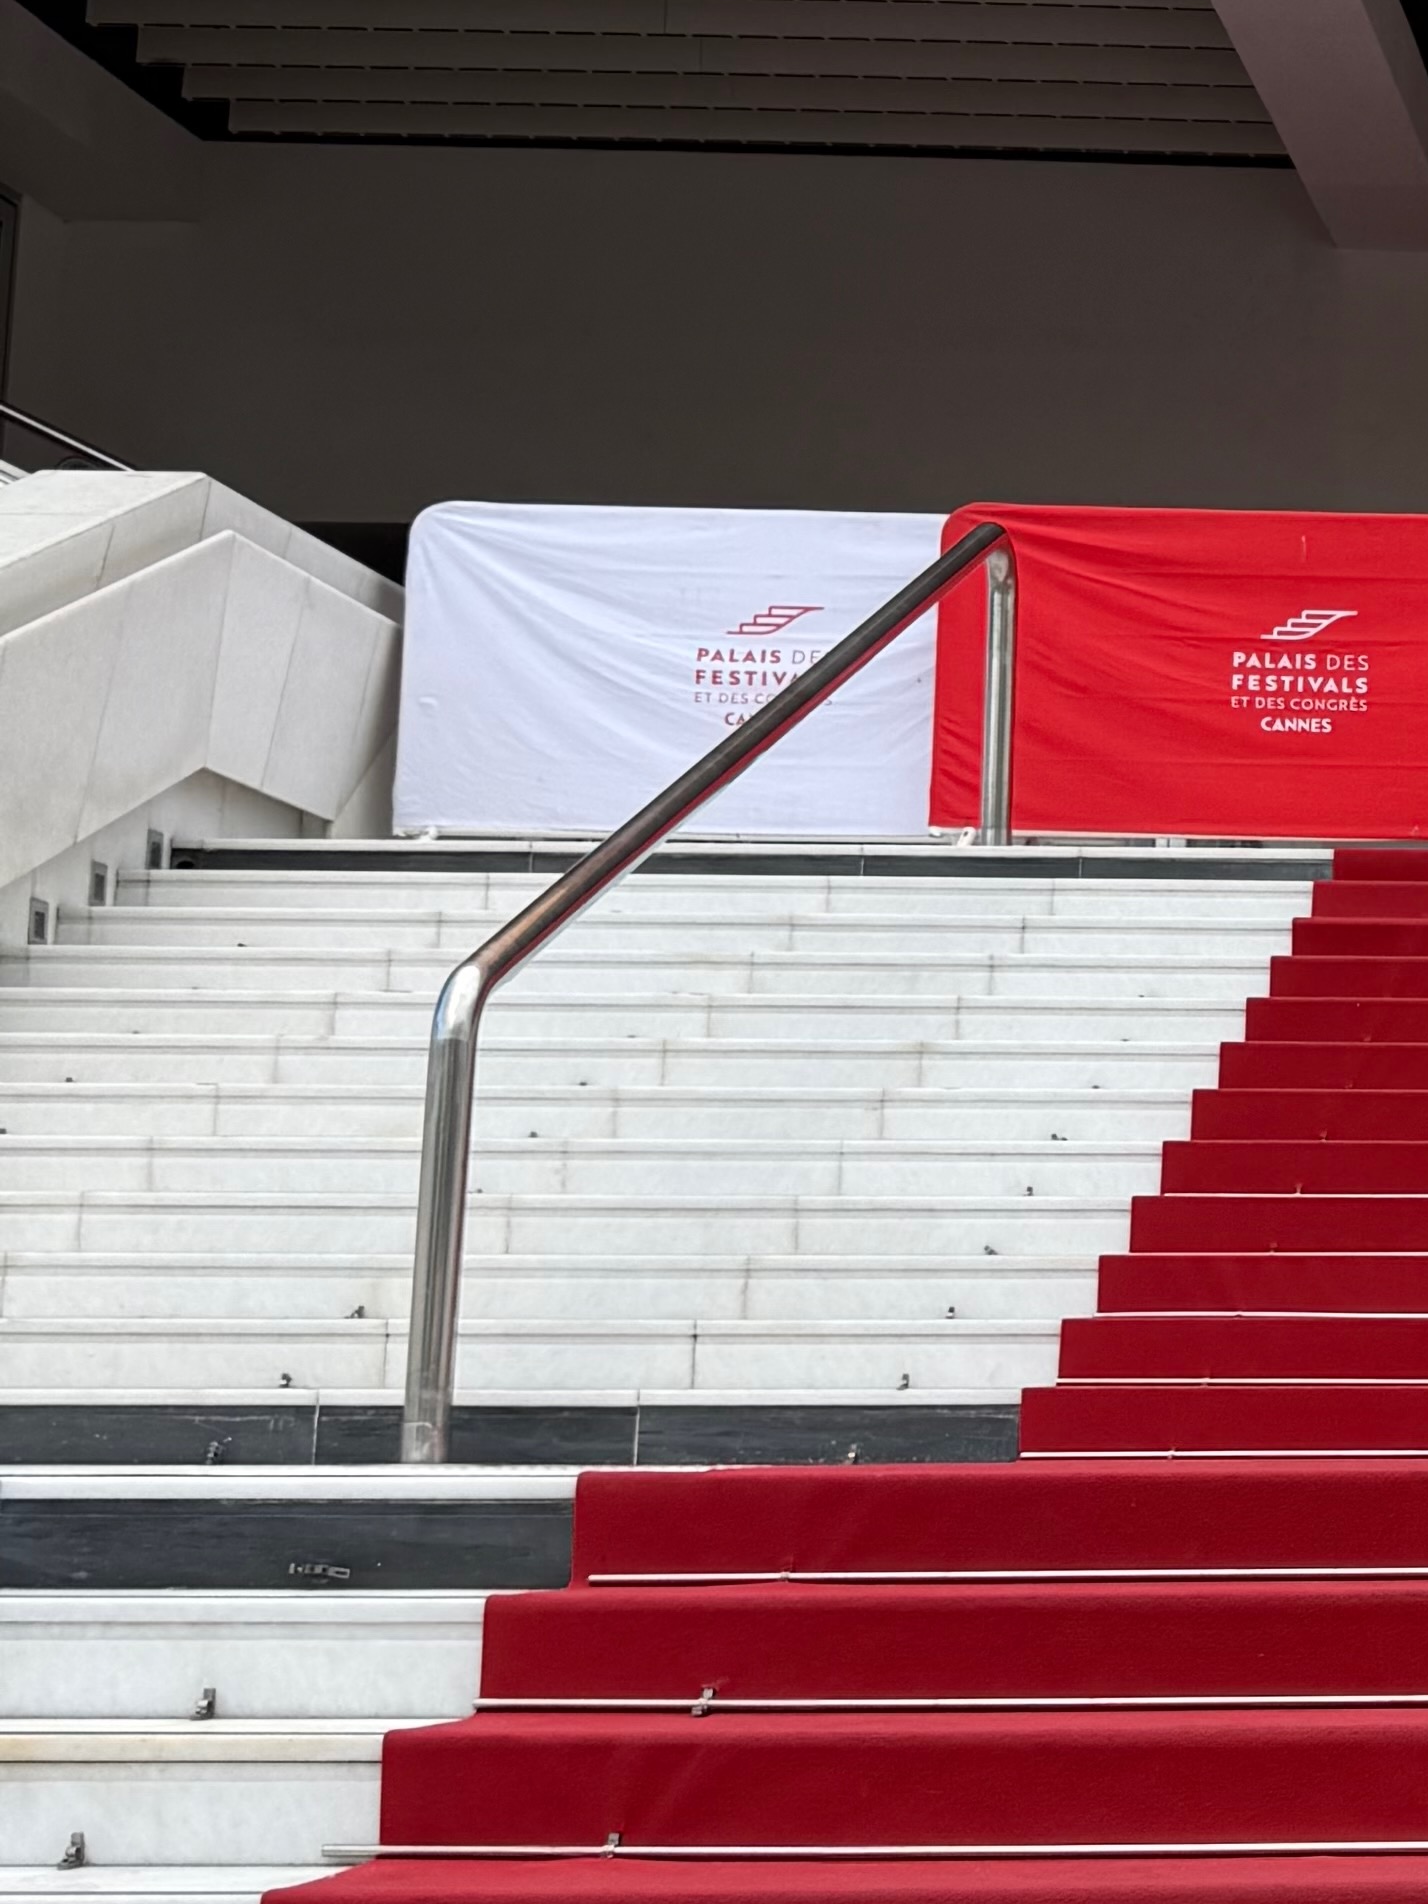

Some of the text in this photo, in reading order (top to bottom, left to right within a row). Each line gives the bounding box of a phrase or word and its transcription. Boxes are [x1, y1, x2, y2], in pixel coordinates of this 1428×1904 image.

[696, 647, 823, 665] PALAIS DE
[1232, 651, 1369, 671] PALAIS DES
[1231, 674, 1368, 694] FESTIVALS
[694, 691, 712, 704] ET
[719, 692, 749, 705] DES
[1231, 696, 1368, 712] ET DES CONGRÈS
[1260, 716, 1332, 733] CANNES
